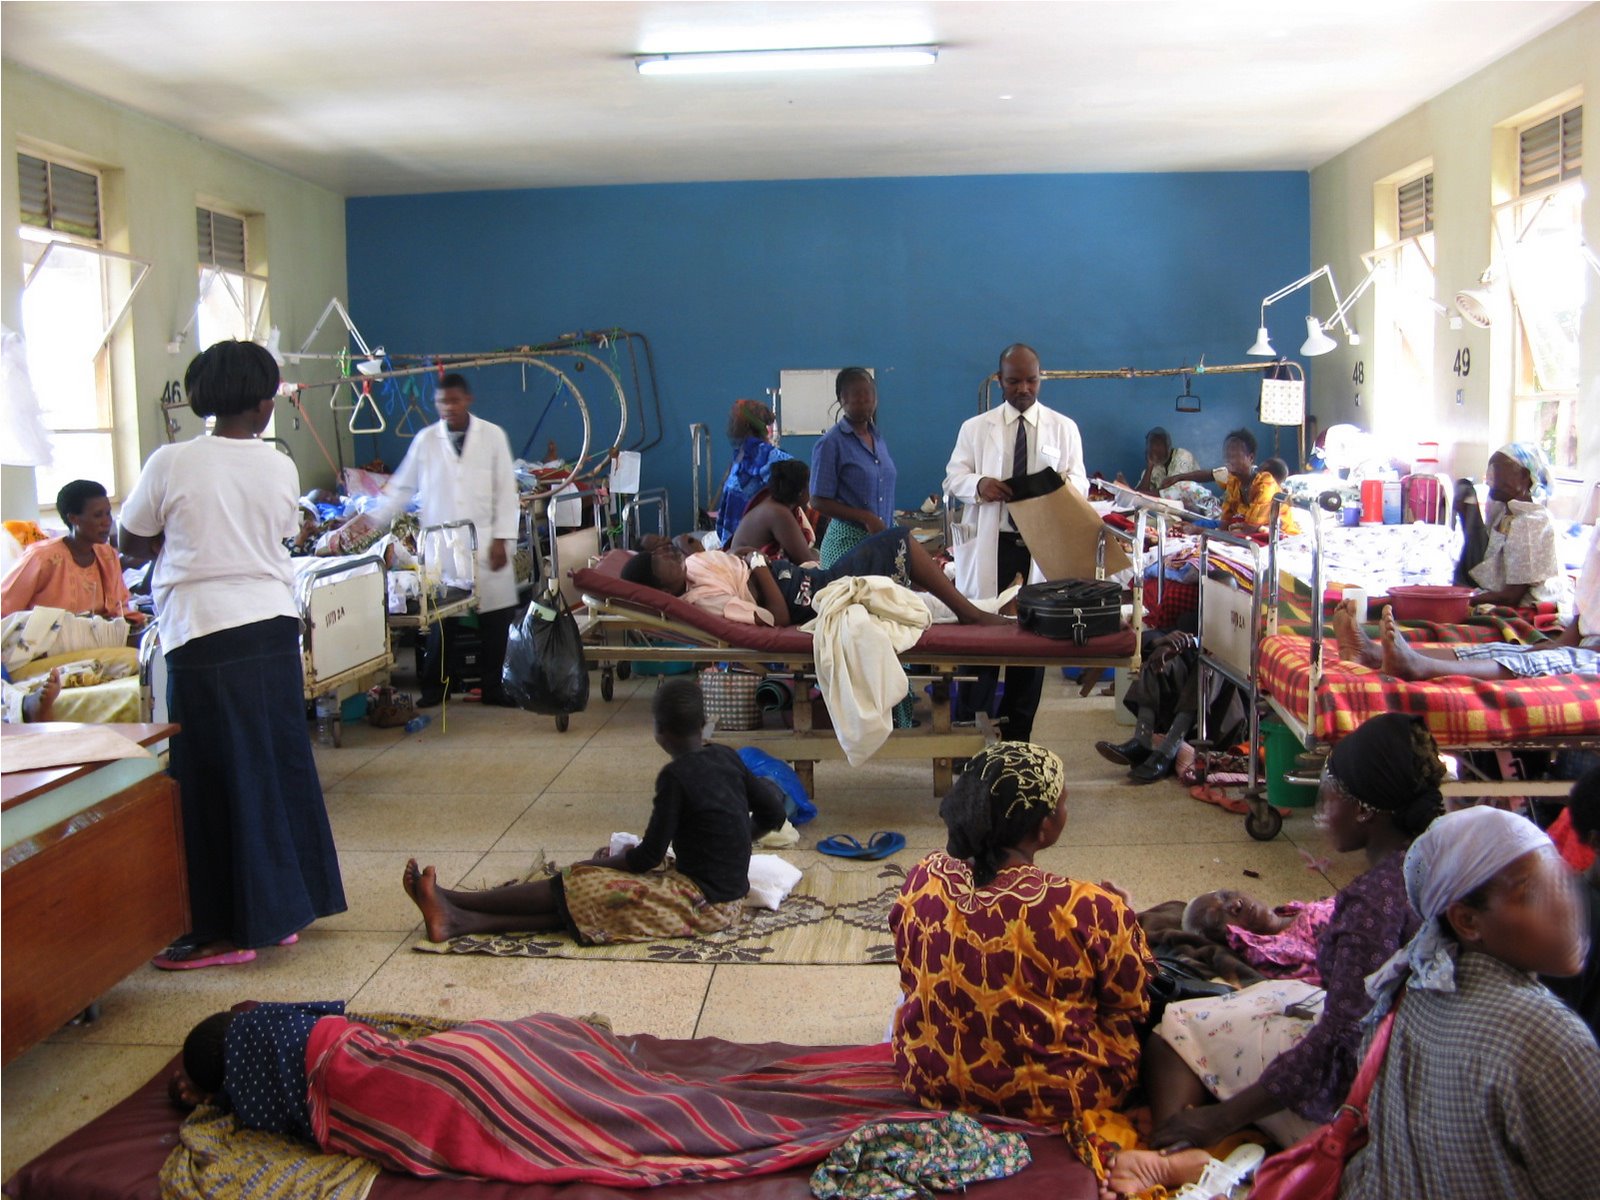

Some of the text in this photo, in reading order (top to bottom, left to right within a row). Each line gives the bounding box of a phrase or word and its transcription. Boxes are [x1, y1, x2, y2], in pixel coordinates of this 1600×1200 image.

[1352, 361, 1364, 386] 48
[1453, 347, 1471, 377] 49
[160, 380, 181, 404] 46
